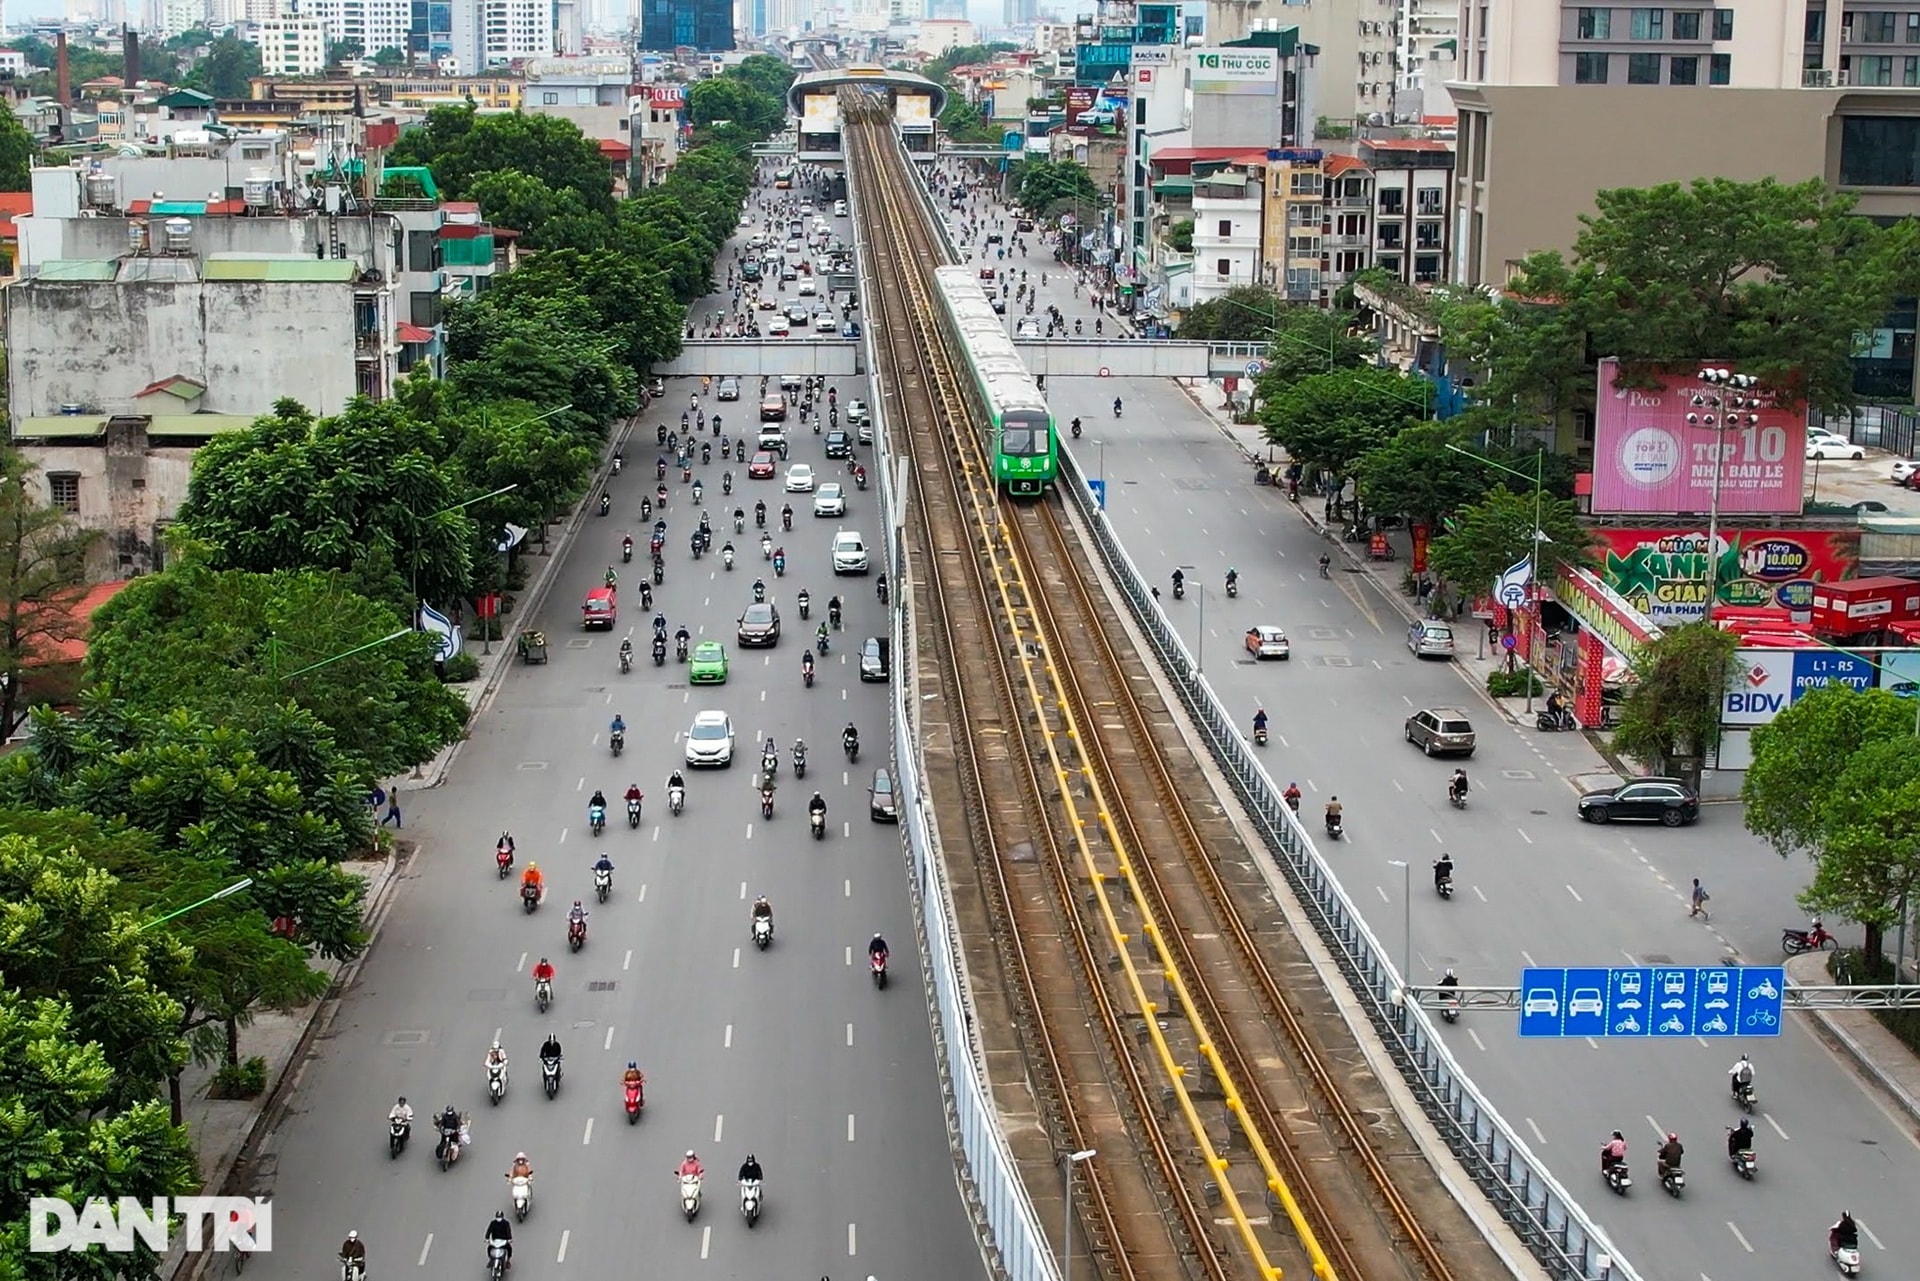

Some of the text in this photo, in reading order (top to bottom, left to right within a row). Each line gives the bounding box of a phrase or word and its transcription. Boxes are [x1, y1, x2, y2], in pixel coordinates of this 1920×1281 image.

[1222, 60, 1242, 69] THU
[650, 88, 682, 101] HOTEL
[1741, 426, 1786, 463] 10
[1767, 553, 1802, 565] 10.000
[1676, 605, 1706, 615] PHAN
[1813, 661, 1827, 671] L1
[1838, 661, 1853, 671] R5
[1796, 676, 1868, 687] ROYA CITY
[1727, 693, 1784, 713] BIDV
